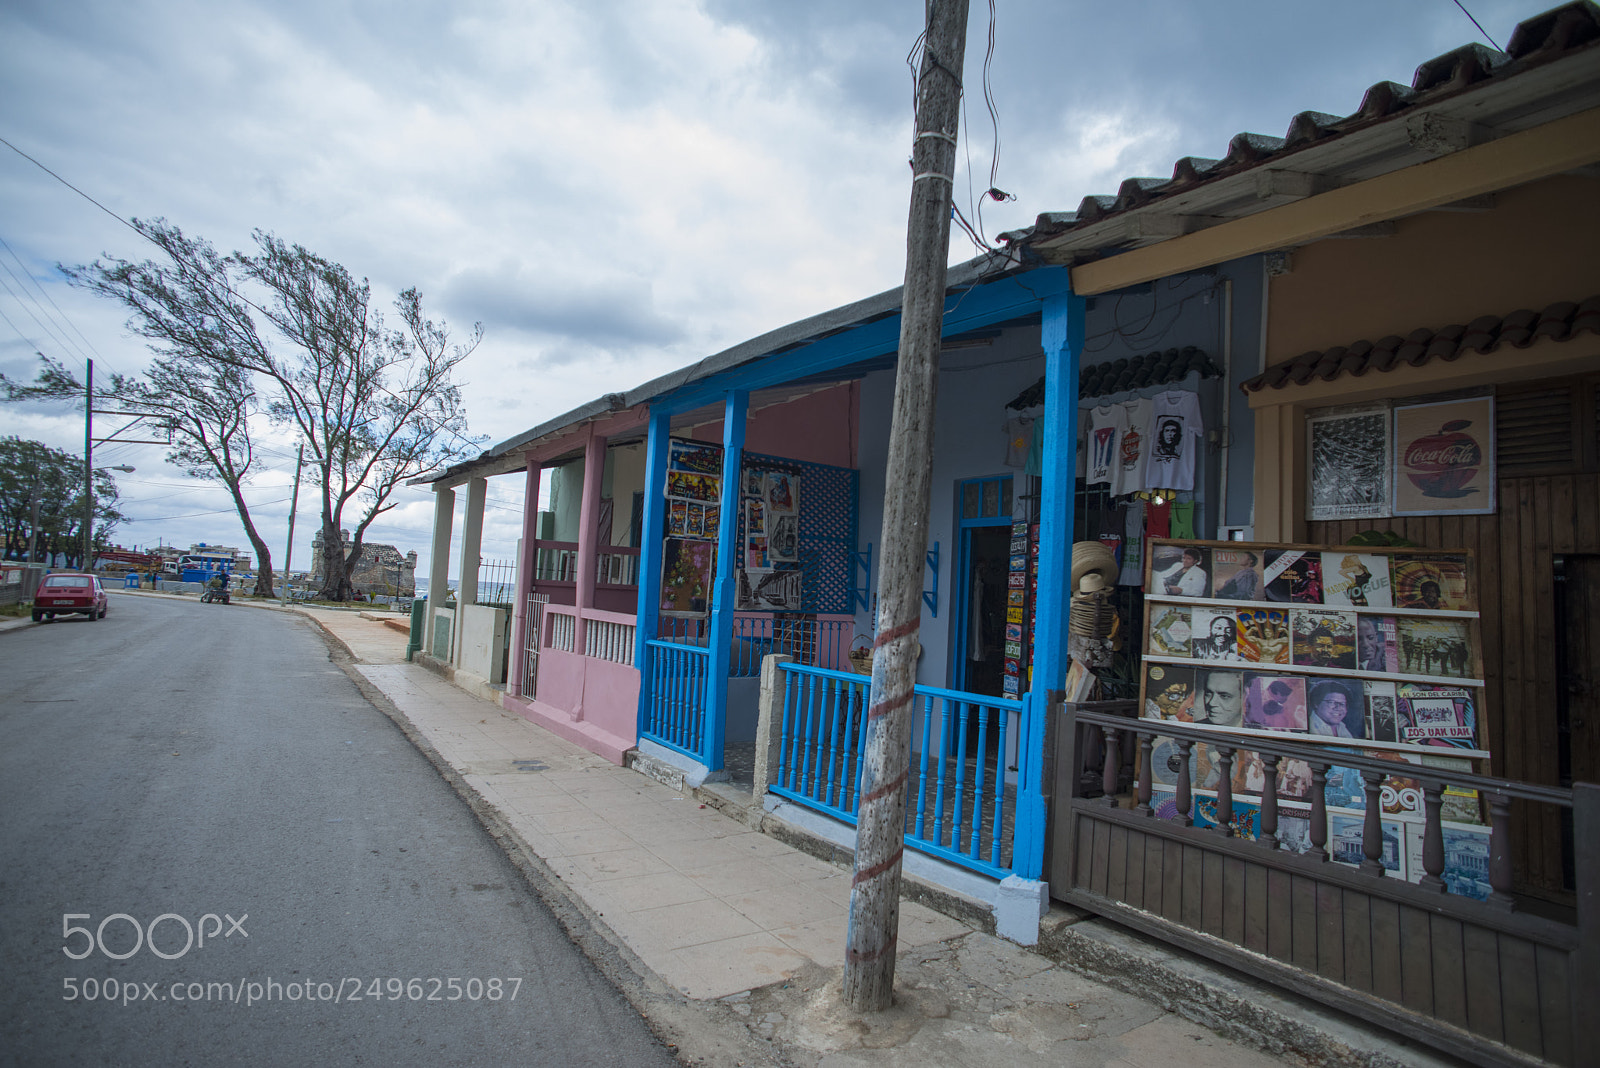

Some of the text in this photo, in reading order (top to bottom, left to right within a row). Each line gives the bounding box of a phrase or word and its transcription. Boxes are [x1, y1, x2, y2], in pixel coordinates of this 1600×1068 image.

[1408, 444, 1474, 466] Coca-Cola
[1216, 551, 1238, 562] ELVIS
[1343, 576, 1389, 599] VOGUE
[1407, 728, 1425, 737] LOS
